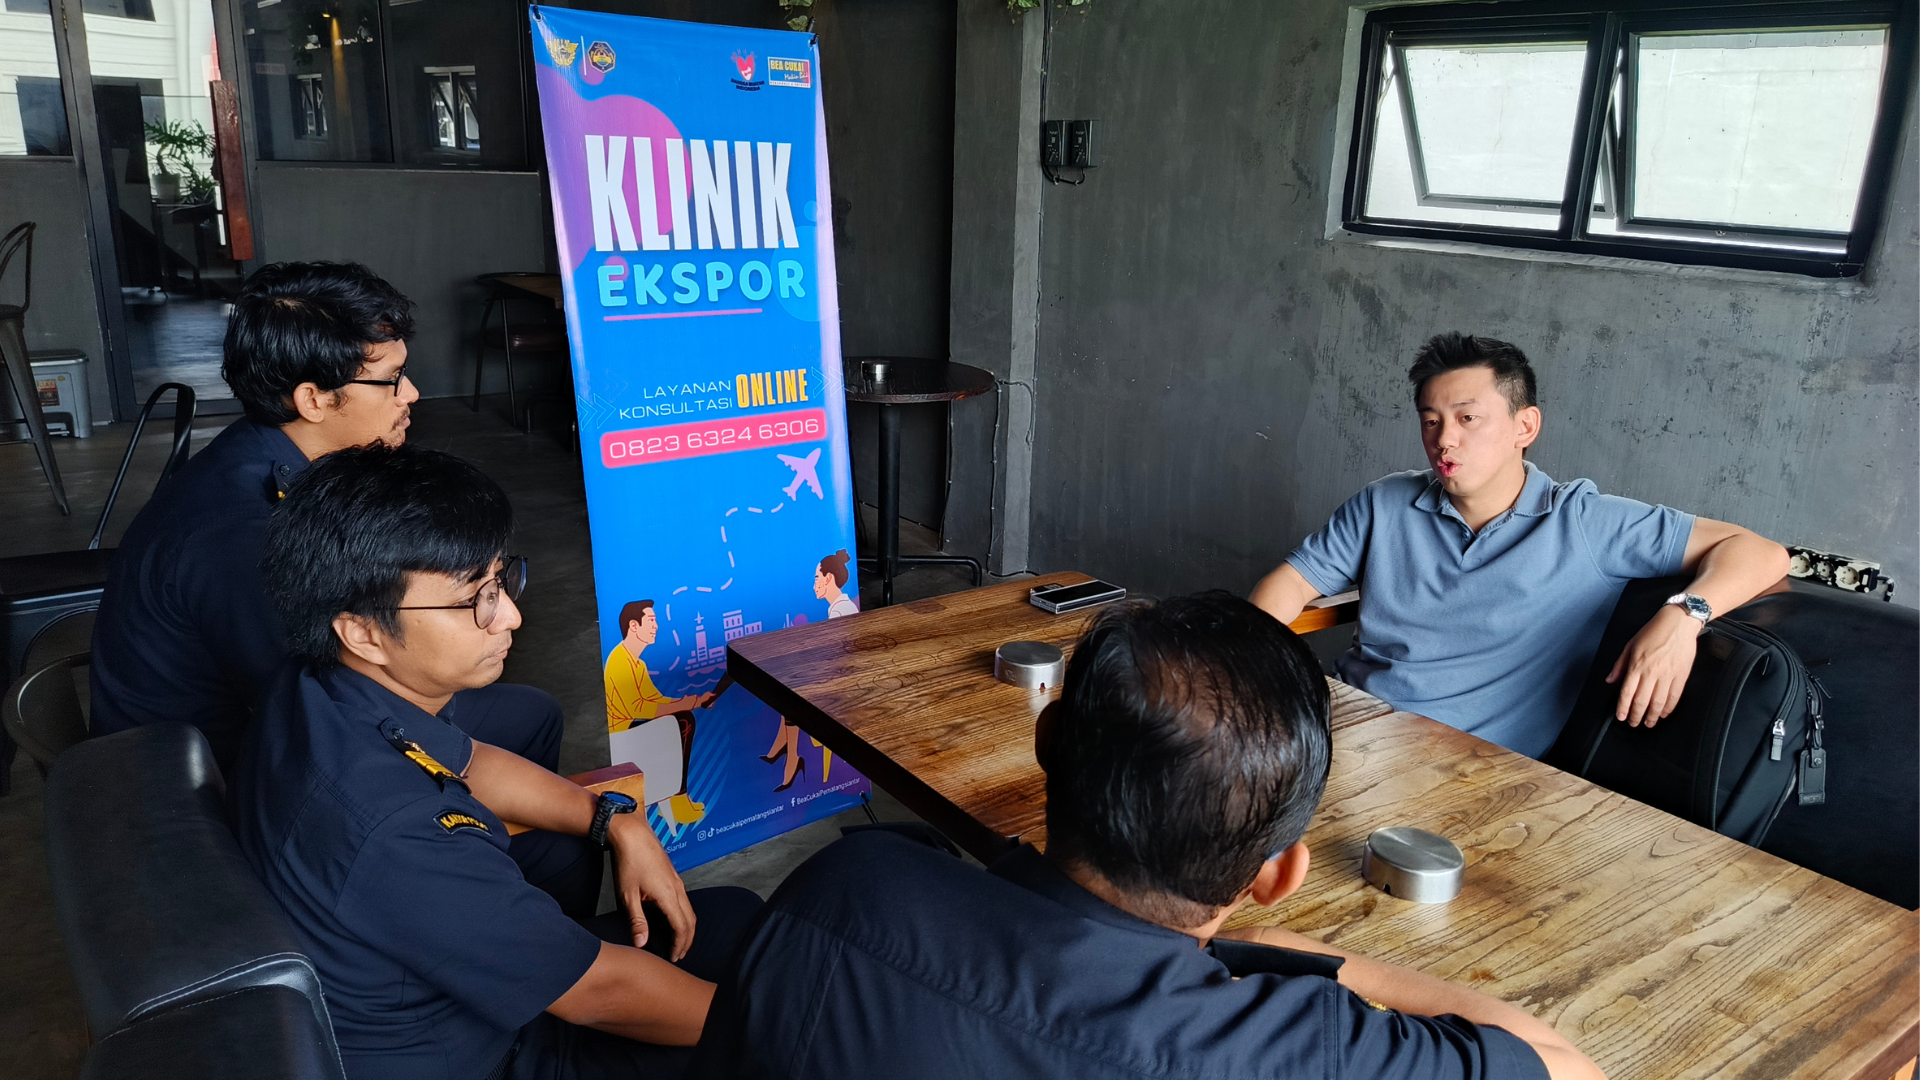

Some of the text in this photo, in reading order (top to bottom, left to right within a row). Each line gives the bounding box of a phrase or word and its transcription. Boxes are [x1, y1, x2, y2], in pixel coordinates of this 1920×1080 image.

[770, 60, 804, 71] BEA CUKAI
[585, 135, 799, 252] KLINIK
[597, 260, 806, 307] EKSPOR
[643, 380, 731, 399] LAYANAN
[735, 369, 808, 408] ONLINE
[619, 397, 733, 420] KONSULTASI
[609, 418, 819, 459] 0823 6324 6306
[796, 777, 860, 805] BeaCukaiPematangsiantar
[716, 805, 784, 834] beacukaipematangsiantar
